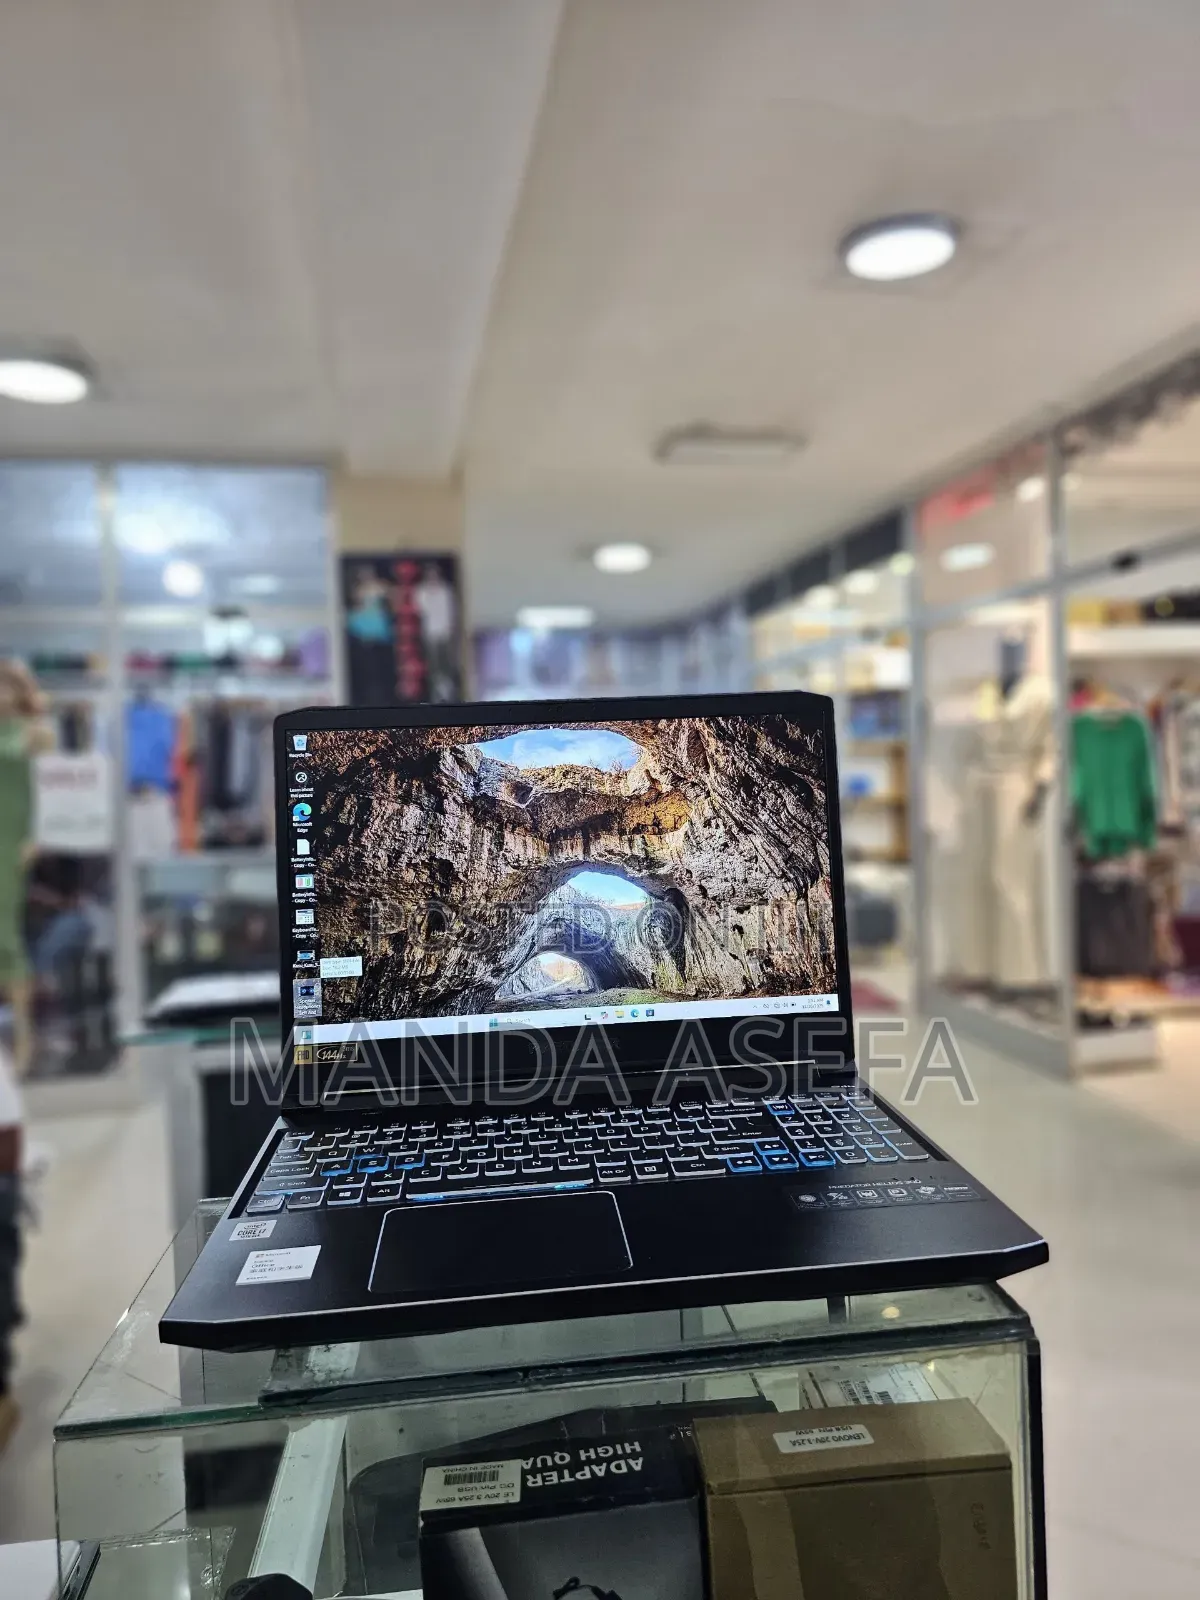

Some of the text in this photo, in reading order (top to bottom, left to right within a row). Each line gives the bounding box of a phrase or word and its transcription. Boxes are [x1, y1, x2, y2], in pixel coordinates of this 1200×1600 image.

[831, 1432, 865, 1442] LENOVO
[580, 1441, 642, 1461] HIGH
[526, 1456, 644, 1488] ADAPTER
